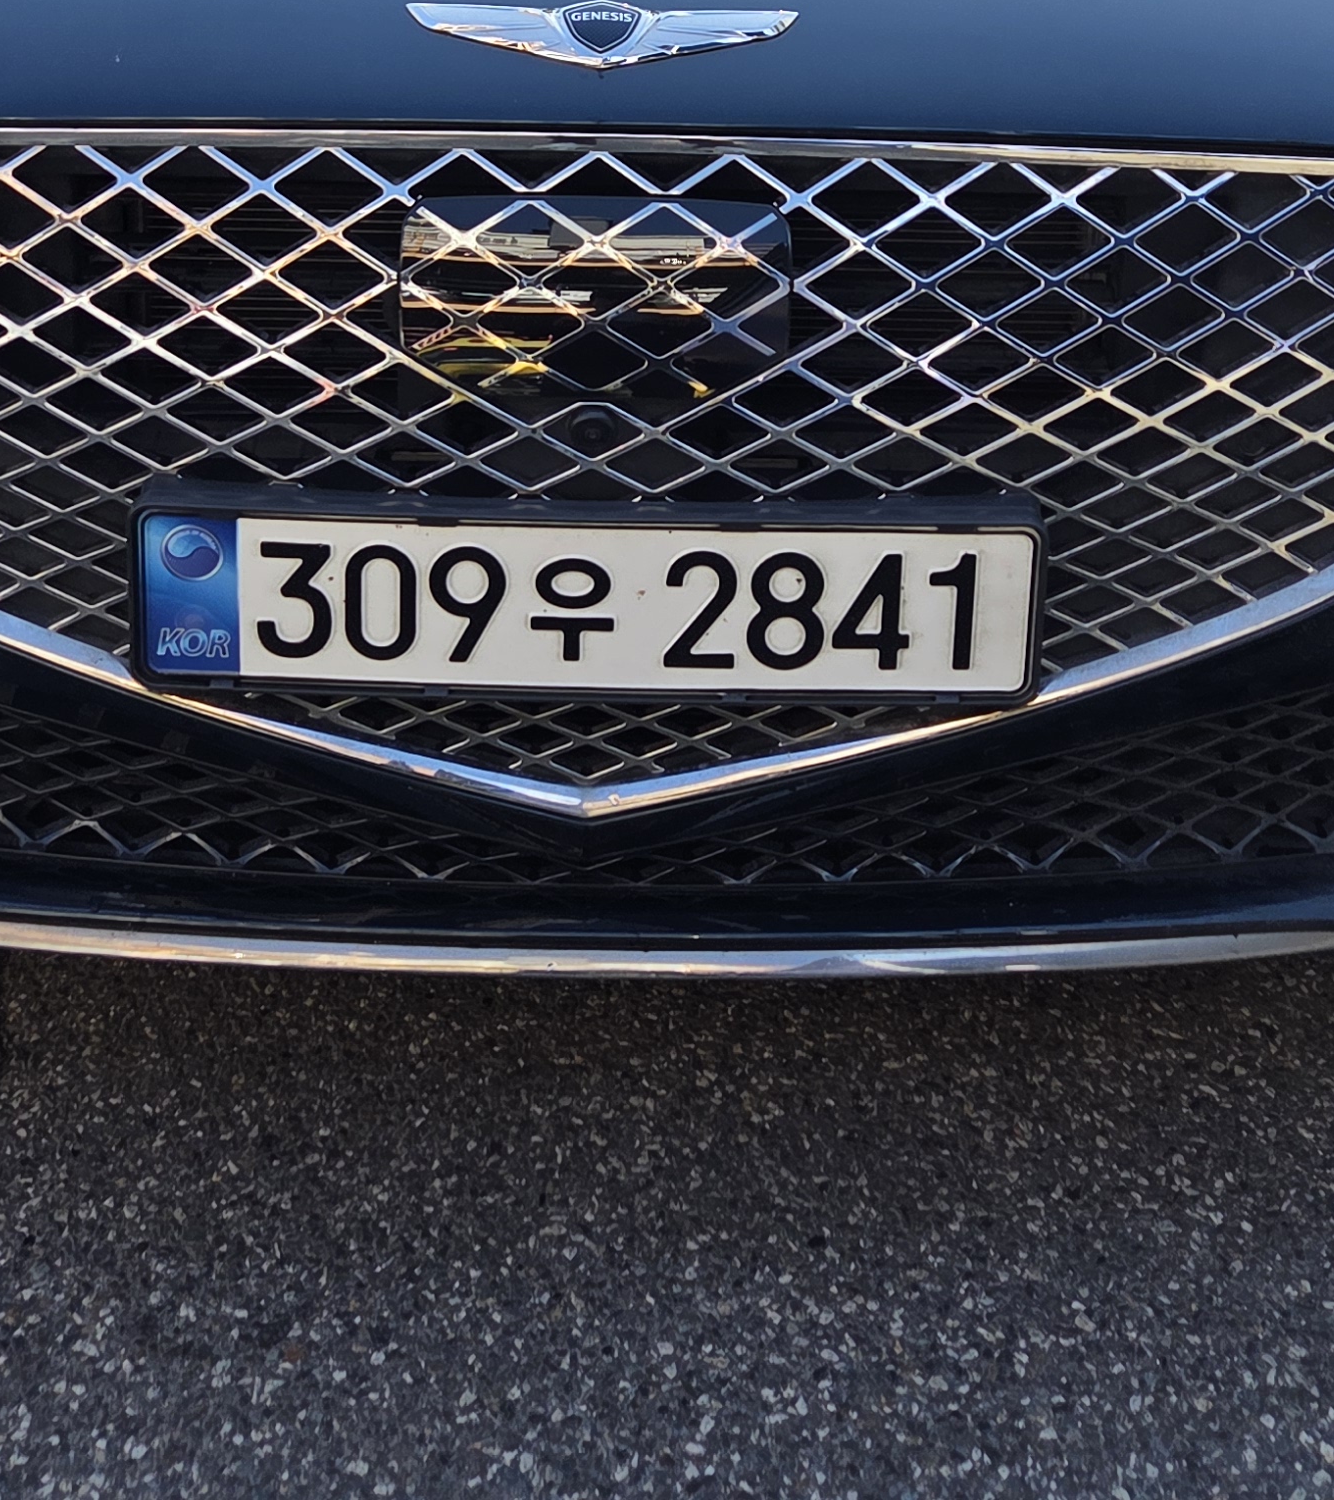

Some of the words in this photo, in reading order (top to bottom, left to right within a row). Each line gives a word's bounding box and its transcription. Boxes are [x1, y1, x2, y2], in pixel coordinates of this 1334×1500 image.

[570, 11, 633, 24] GENESIS
[256, 541, 615, 664] 309우
[662, 550, 977, 671] 2841
[156, 627, 231, 658] KOR
